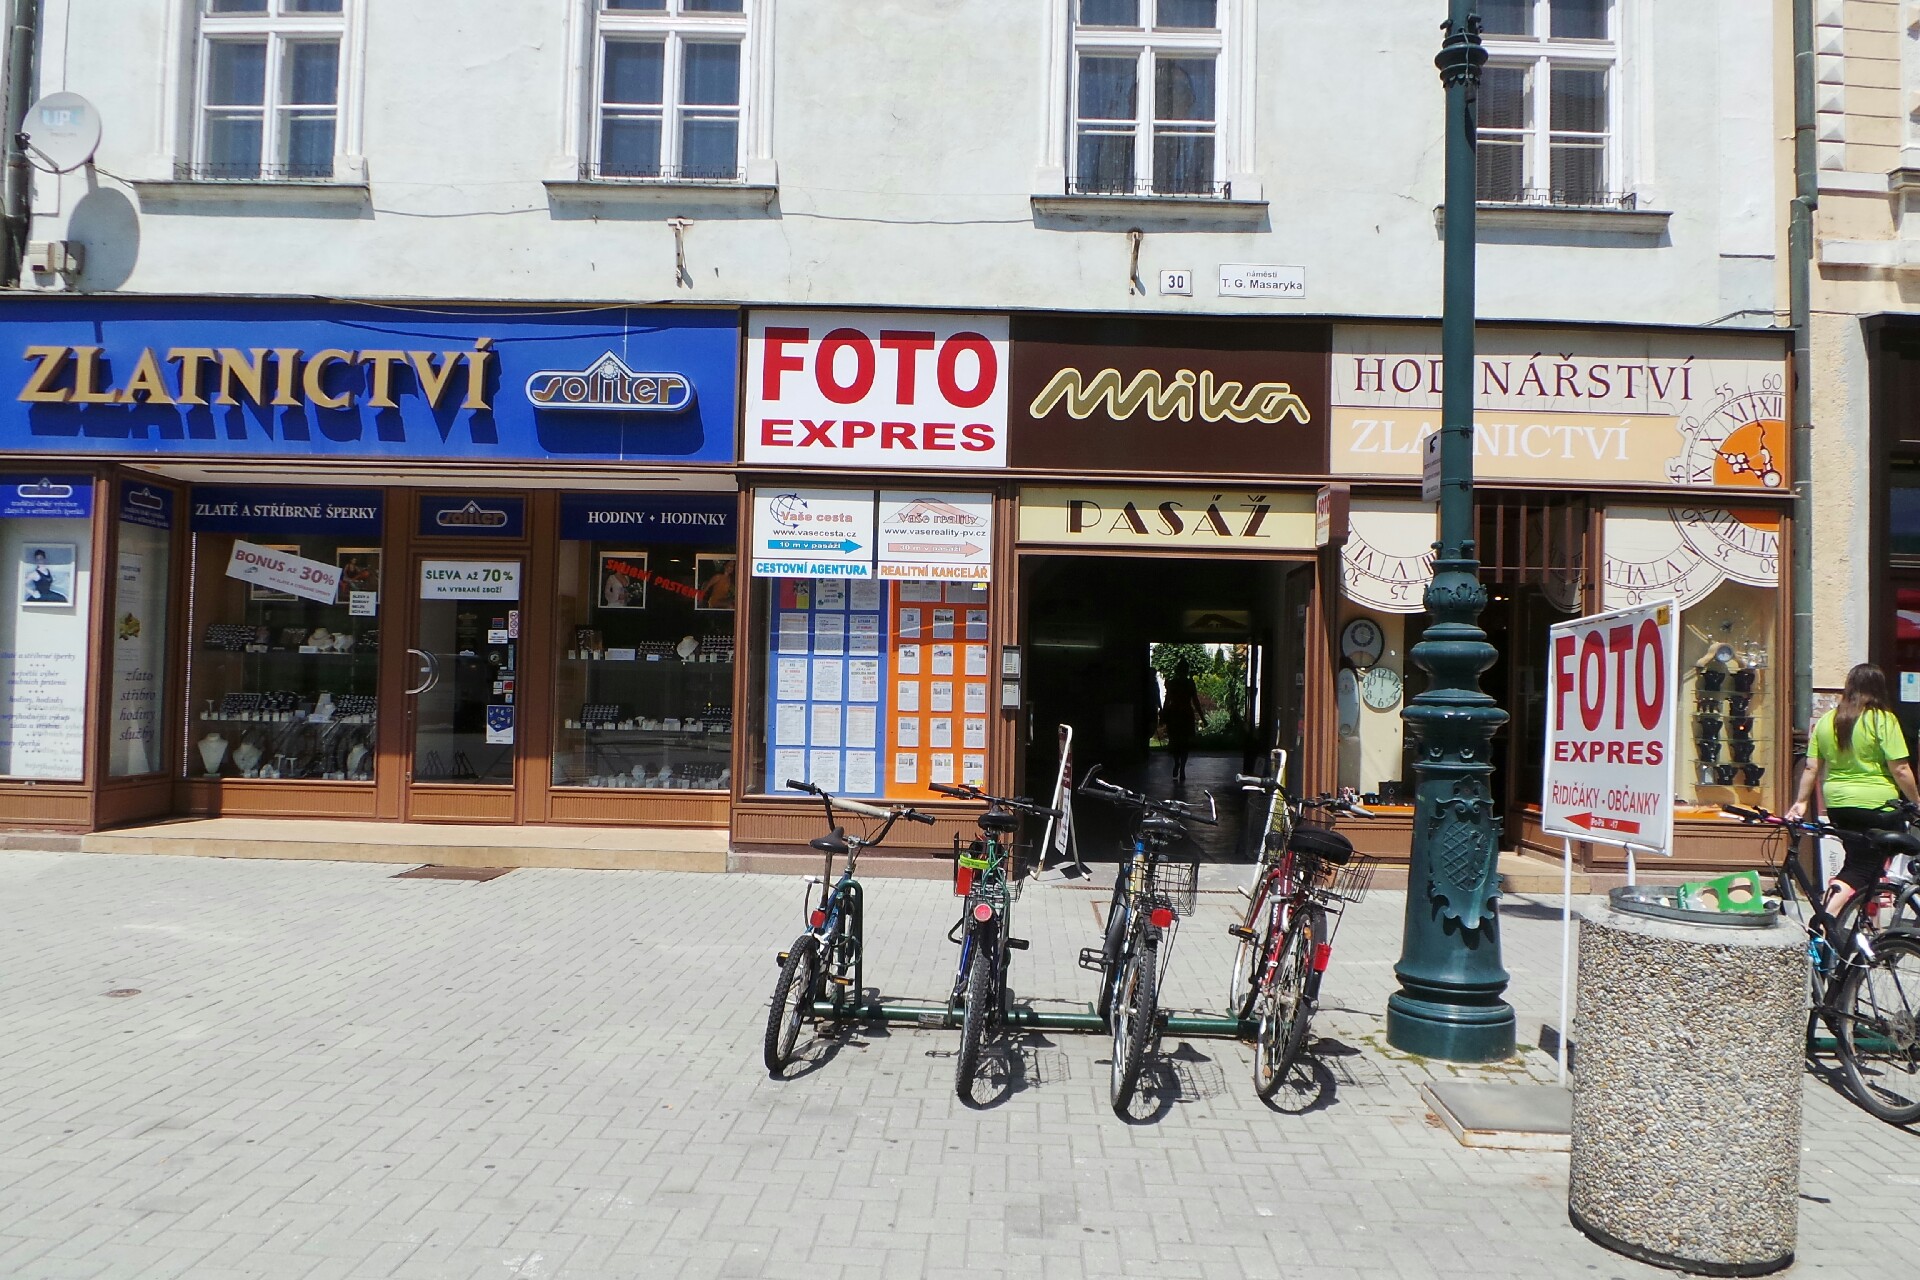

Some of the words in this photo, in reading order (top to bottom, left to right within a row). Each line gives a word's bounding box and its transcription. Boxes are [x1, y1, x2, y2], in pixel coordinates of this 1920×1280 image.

[1168, 274, 1184, 288] 30
[1222, 279, 1230, 288] T.
[1234, 279, 1246, 288] G.
[1250, 280, 1302, 292] Masaryka
[16, 337, 492, 411] ZLATNICTVÍ
[762, 327, 998, 408] FOTO
[531, 360, 684, 404] soliter
[1762, 373, 1782, 390] 60
[1029, 367, 1311, 425] mika
[1714, 382, 1734, 403] 55
[1680, 416, 1700, 436] 50
[760, 420, 996, 452] EXPRES
[1350, 420, 1631, 460] ZLANICTVÍ
[195, 503, 238, 516] ZLATÉ
[242, 505, 250, 516] A
[252, 503, 322, 518] STŘÍBRNÉ
[326, 504, 376, 519] ŠPERKY
[588, 512, 645, 524] HODINY
[660, 512, 728, 526] HODINKY
[781, 511, 812, 521] Vaše
[816, 512, 853, 522] cesta
[898, 512, 930, 524] Vaše
[934, 514, 978, 525] reality
[1066, 494, 1272, 538] PASÁŽ
[773, 530, 857, 538] www.vasecesta.cz
[884, 528, 986, 538] www.vasereality-pv.cz
[234, 550, 286, 572] BONUS
[300, 566, 335, 586] 30%
[426, 570, 462, 580] SLEVA
[466, 571, 478, 580] AŽ
[756, 562, 808, 574] CESTOVNÍ
[810, 564, 868, 576] AGENTURA
[880, 565, 928, 576] REALITNÍ
[932, 566, 988, 578] KANCELÁŘ
[125, 668, 153, 682] zlato
[1556, 618, 1664, 732] FOTO
[121, 690, 156, 702] stříbro
[120, 708, 156, 724] hodiny
[120, 726, 155, 743] služby
[1554, 740, 1664, 766] EXPRES
[1552, 779, 1600, 810] ŘIDIČÁKY
[1607, 784, 1660, 816] OBČANKY
[1829, 850, 1838, 876] Reality
